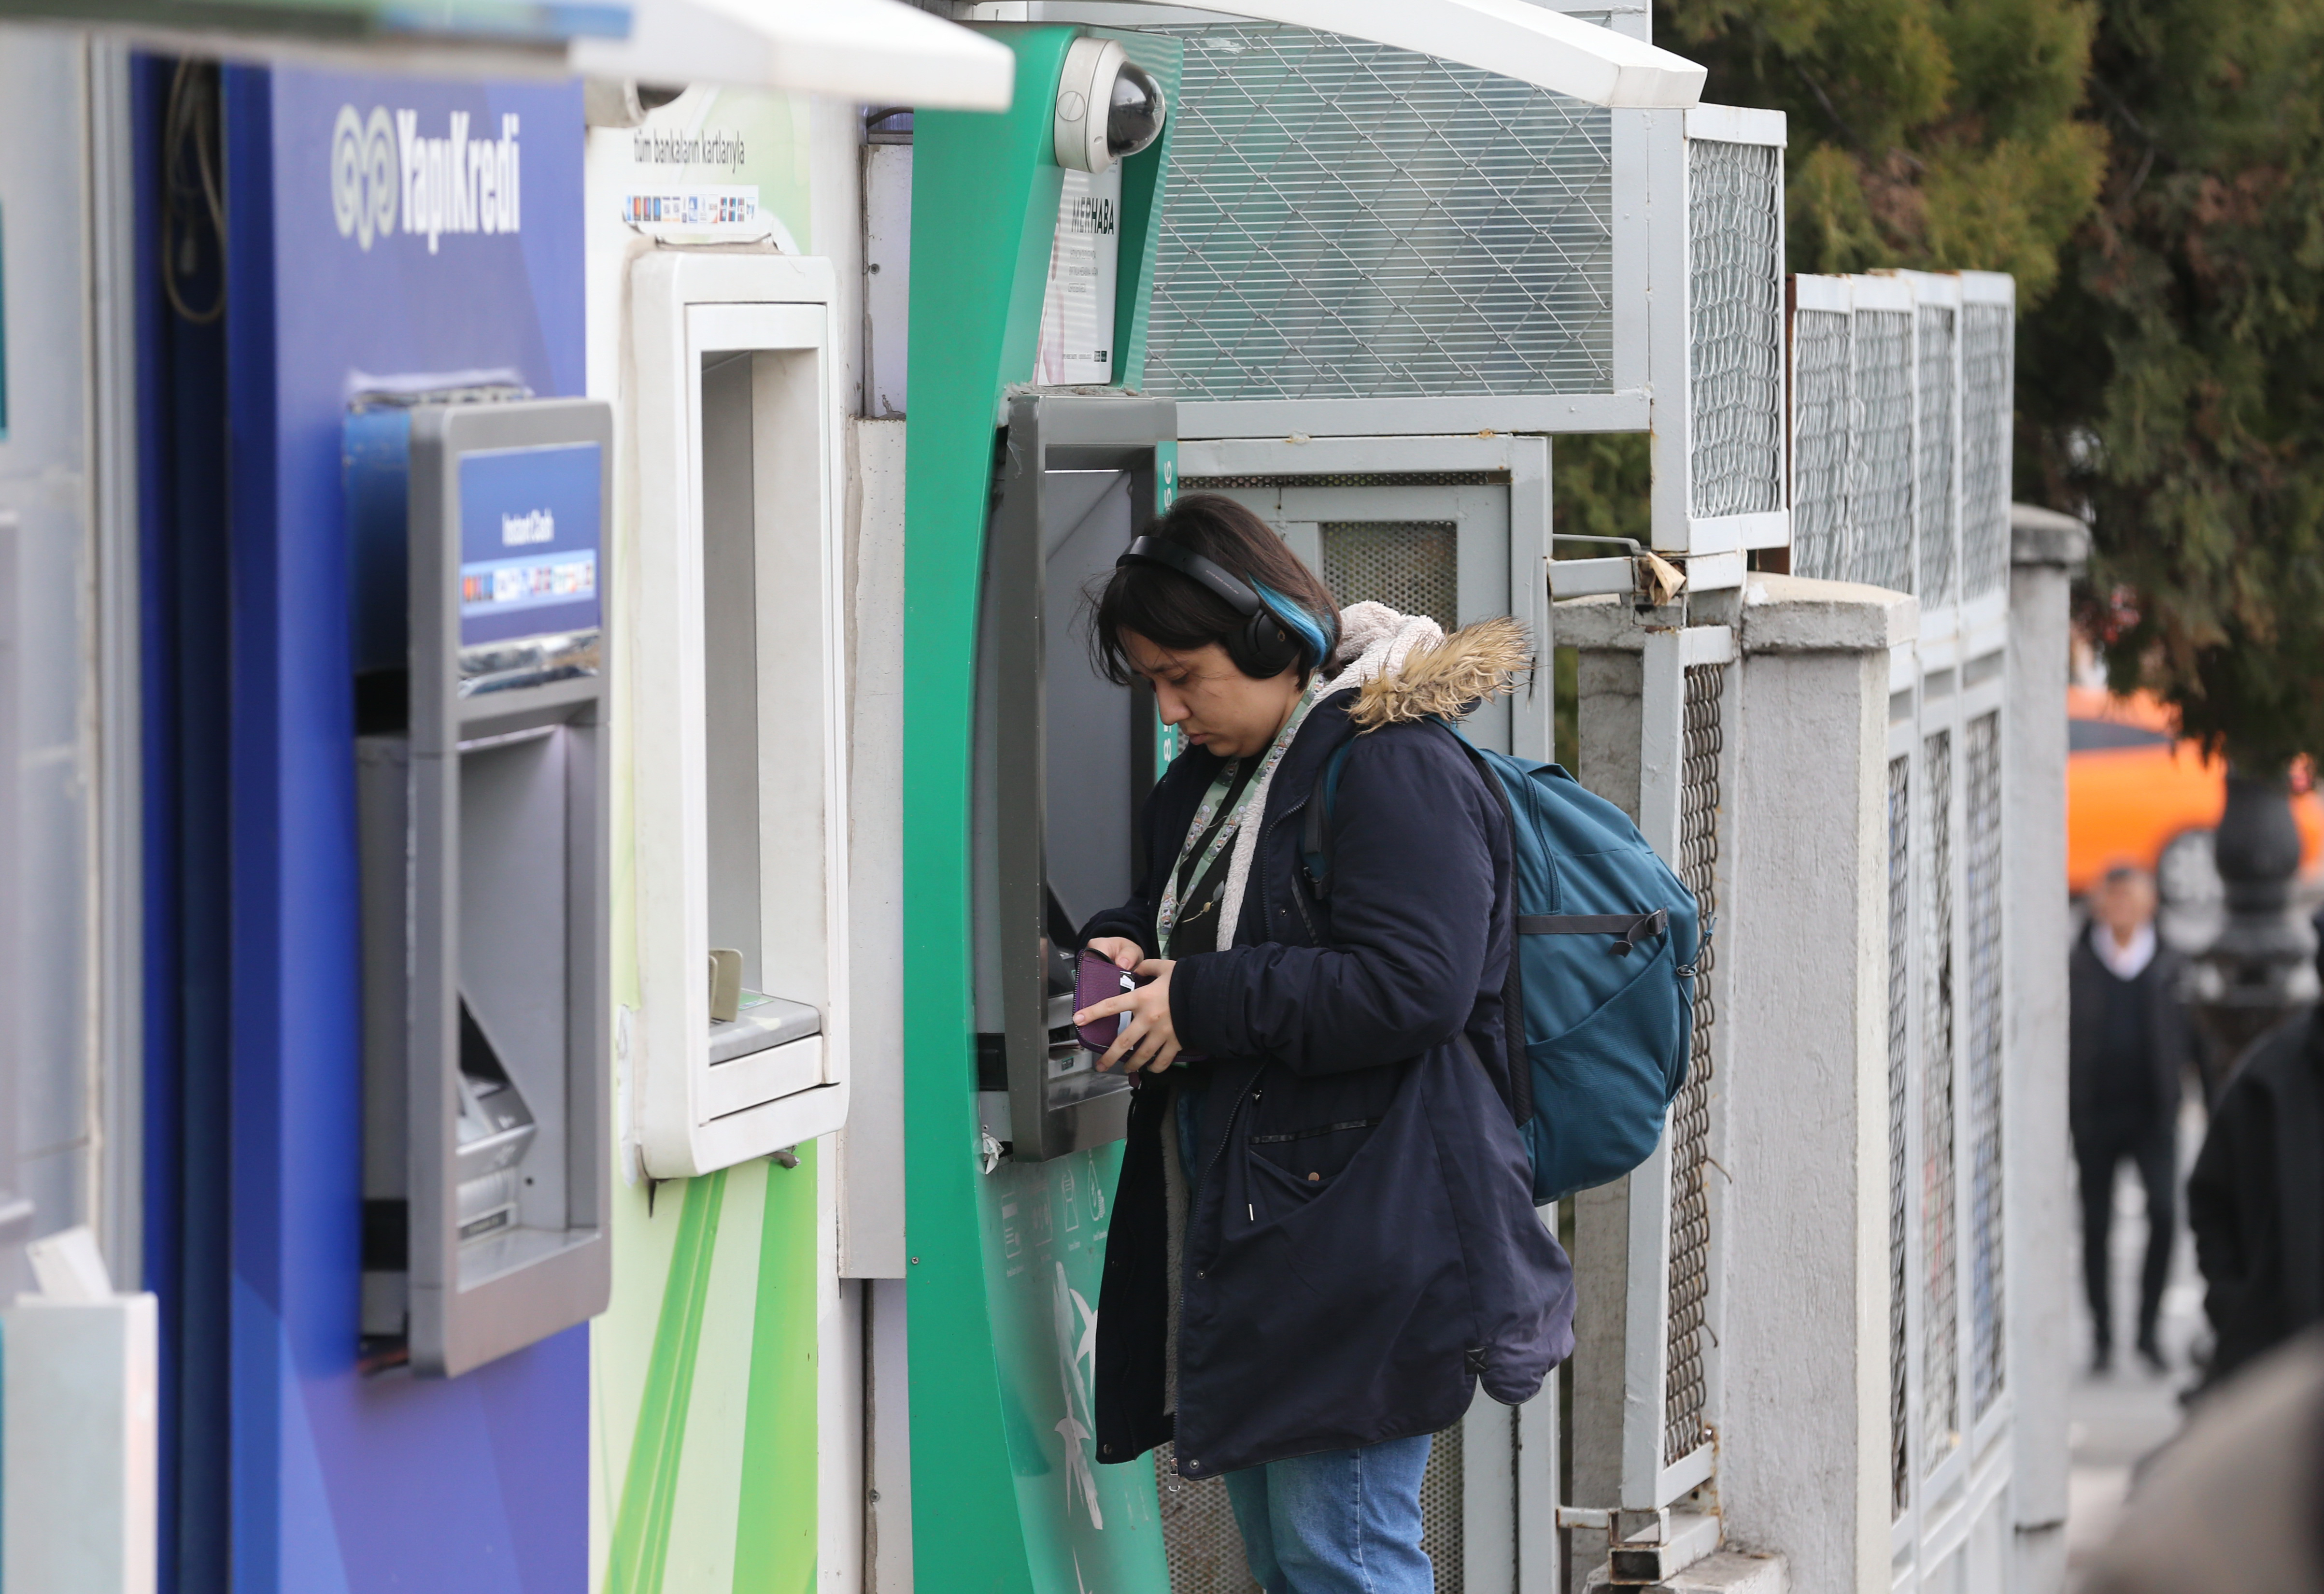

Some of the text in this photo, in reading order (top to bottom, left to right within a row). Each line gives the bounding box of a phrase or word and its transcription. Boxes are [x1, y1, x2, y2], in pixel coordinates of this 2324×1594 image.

[653, 128, 699, 163] bankaların
[702, 129, 745, 174] kartlarıyla
[1072, 197, 1114, 235] MERHABA
